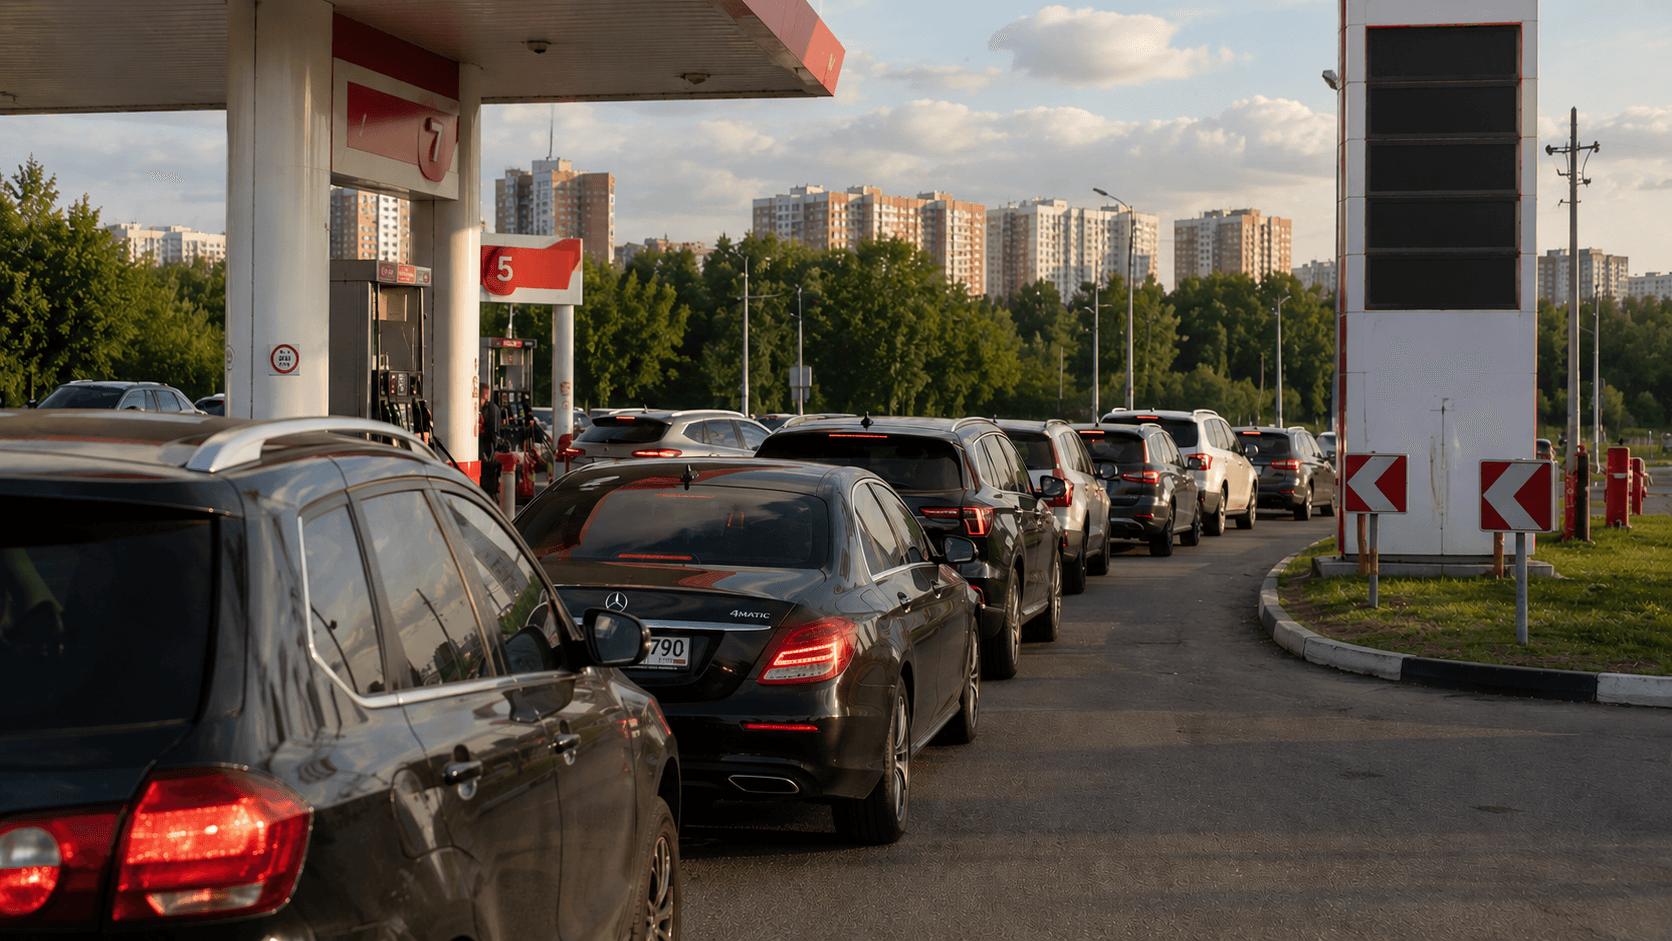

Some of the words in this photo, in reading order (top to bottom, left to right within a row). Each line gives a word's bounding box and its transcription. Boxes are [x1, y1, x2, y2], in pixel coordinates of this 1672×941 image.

[427, 118, 444, 162] 7
[496, 256, 513, 282] 5
[730, 609, 771, 619] 4MATIC
[650, 638, 685, 657] 790
